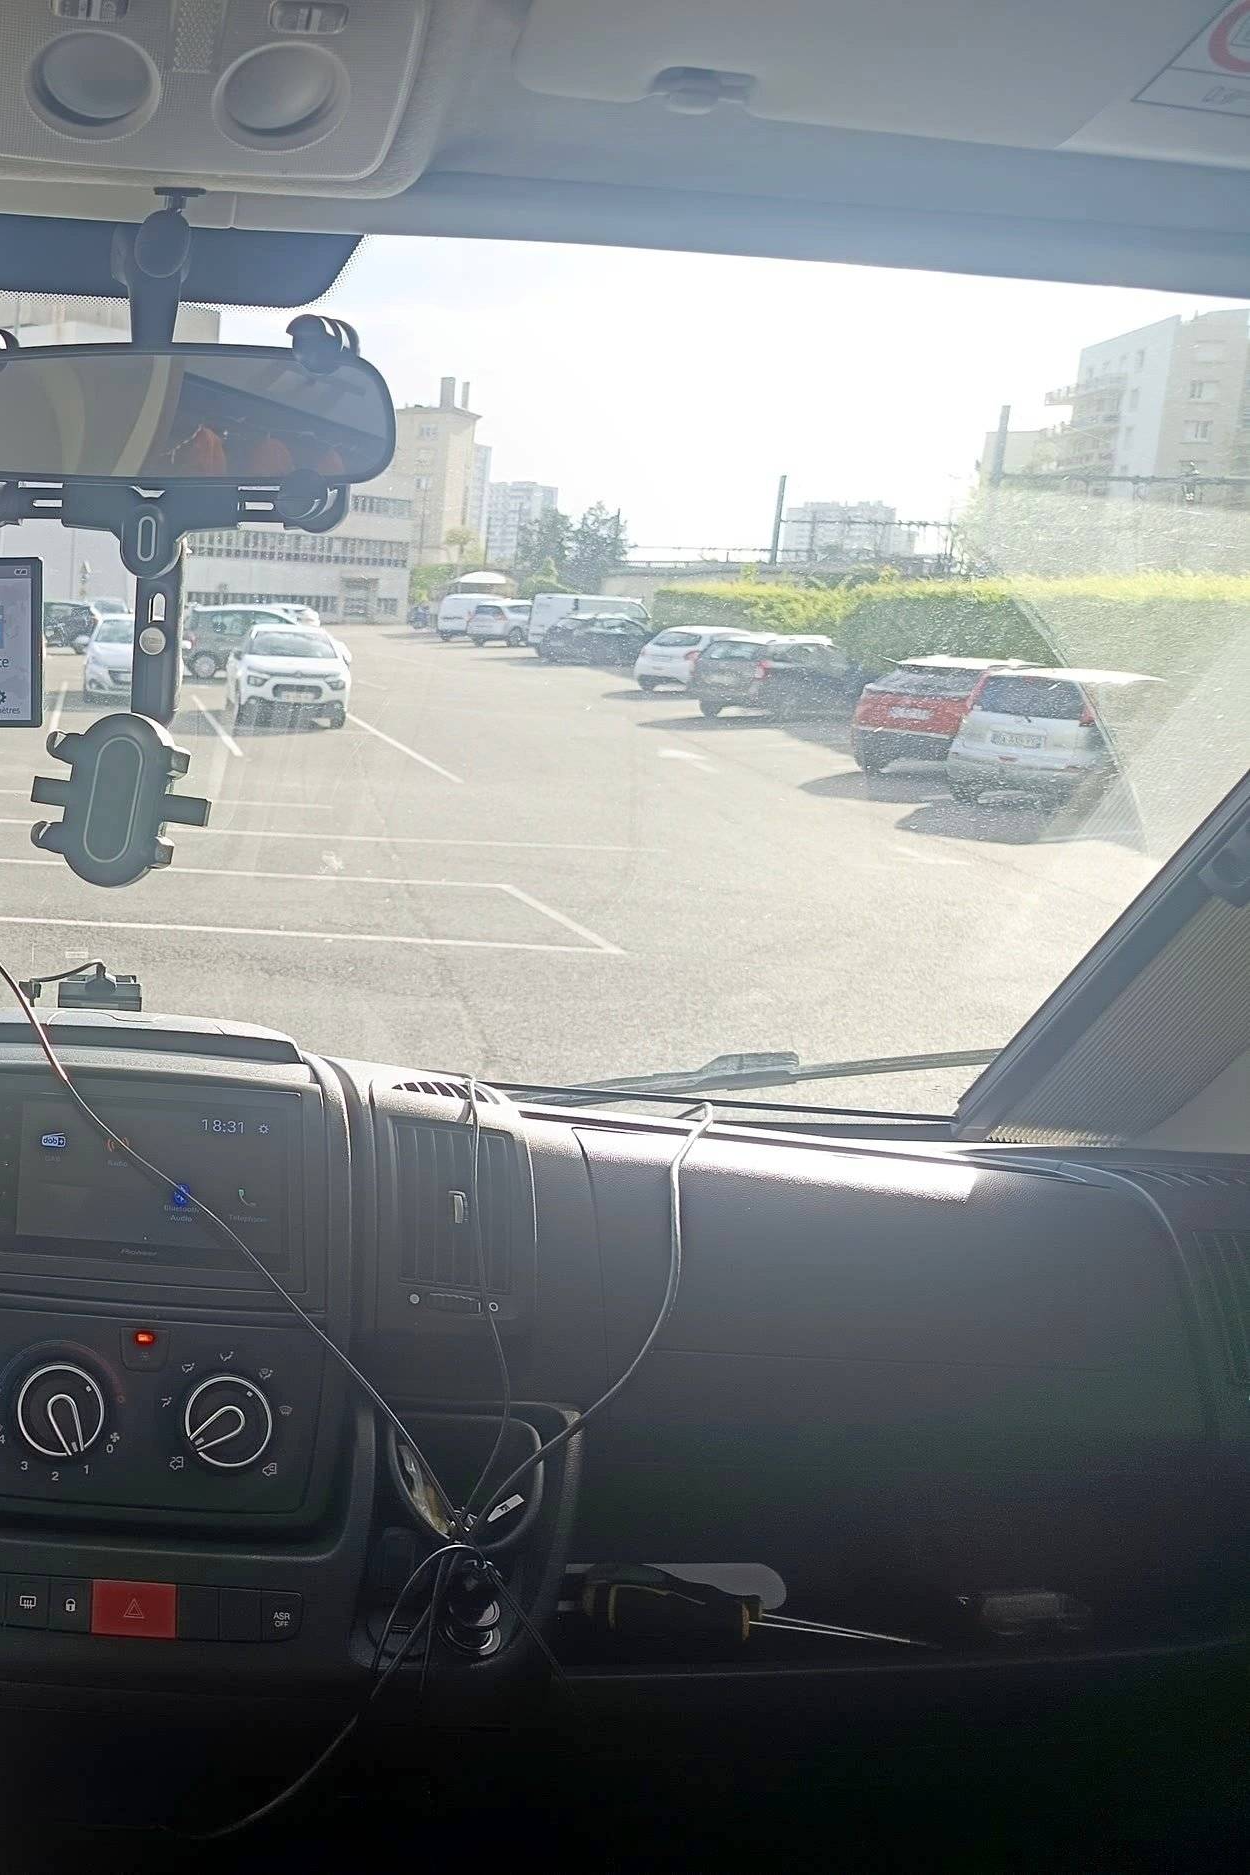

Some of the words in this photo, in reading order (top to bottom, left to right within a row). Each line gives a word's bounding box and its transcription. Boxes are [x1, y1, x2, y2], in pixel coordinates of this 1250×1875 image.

[201, 1118, 245, 1134] 18:31
[170, 1213, 193, 1223] Audio
[20, 1460, 29, 1471] 3
[83, 1465, 90, 1475] 1
[51, 1471, 59, 1481] 2
[273, 1611, 290, 1620] ASR
[274, 1620, 290, 1628] OFF
